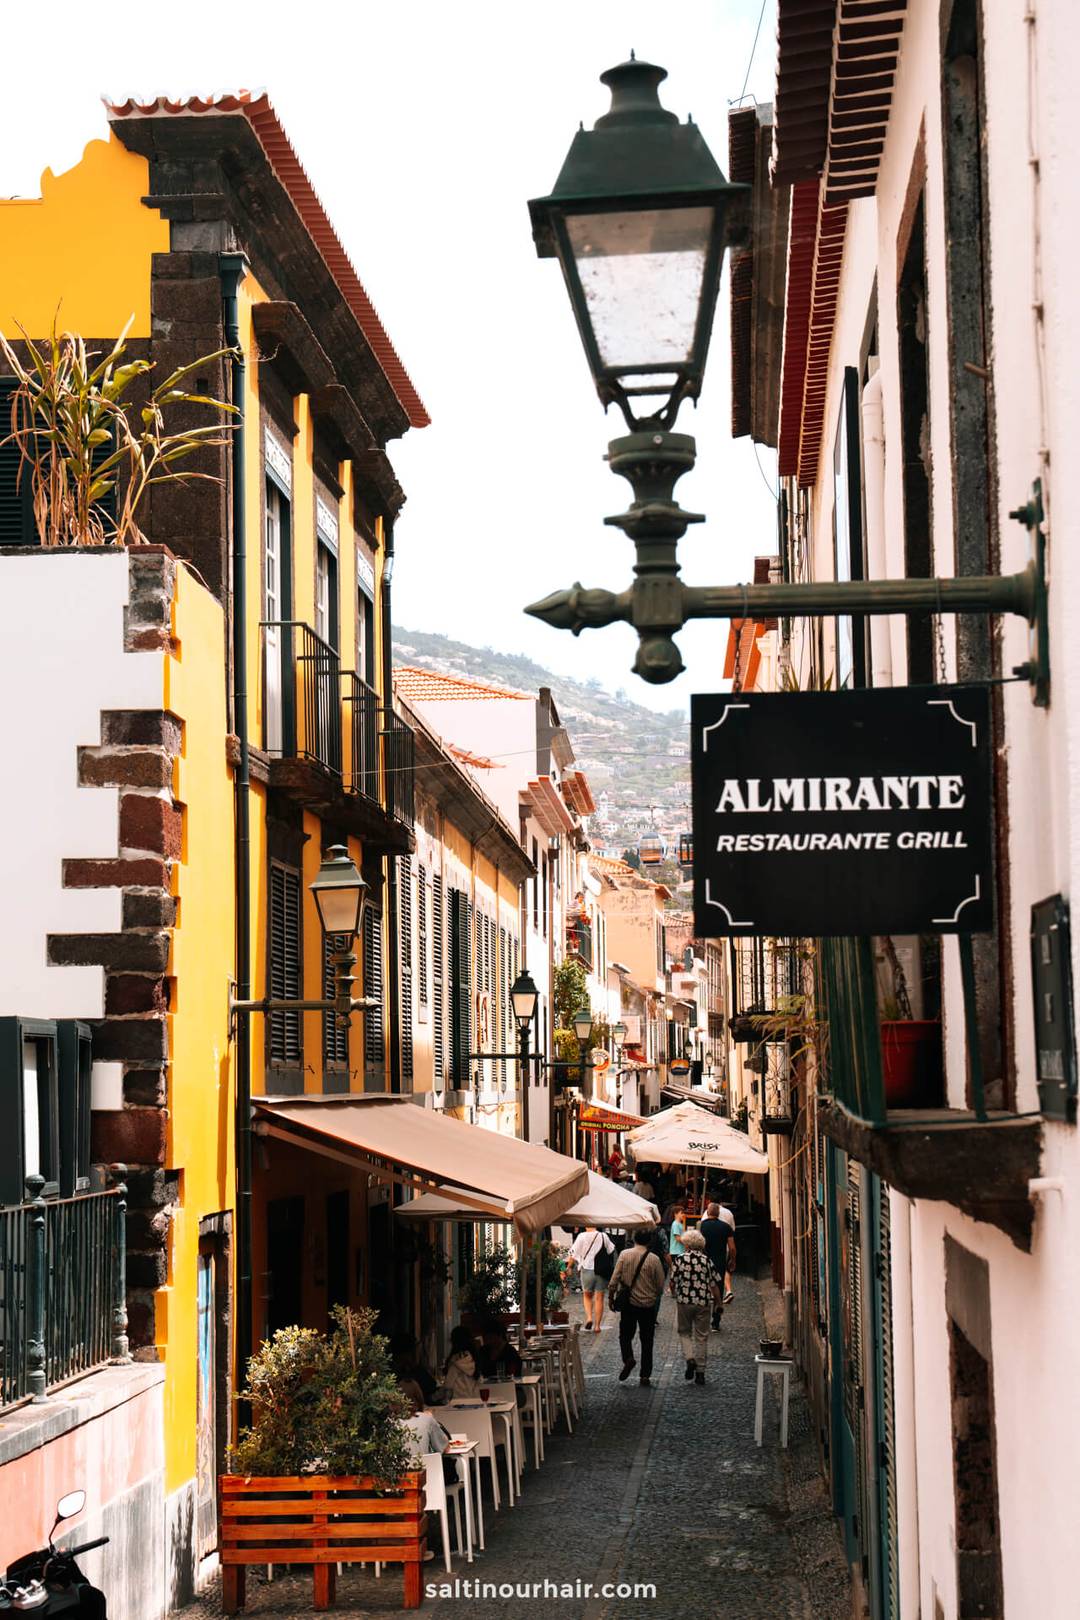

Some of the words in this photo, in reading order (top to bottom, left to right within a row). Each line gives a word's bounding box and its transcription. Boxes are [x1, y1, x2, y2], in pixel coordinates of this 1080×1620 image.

[715, 775, 966, 813] ALMIRANTE
[717, 832, 891, 852] RESTAURANTE
[896, 831, 968, 849] GRILL
